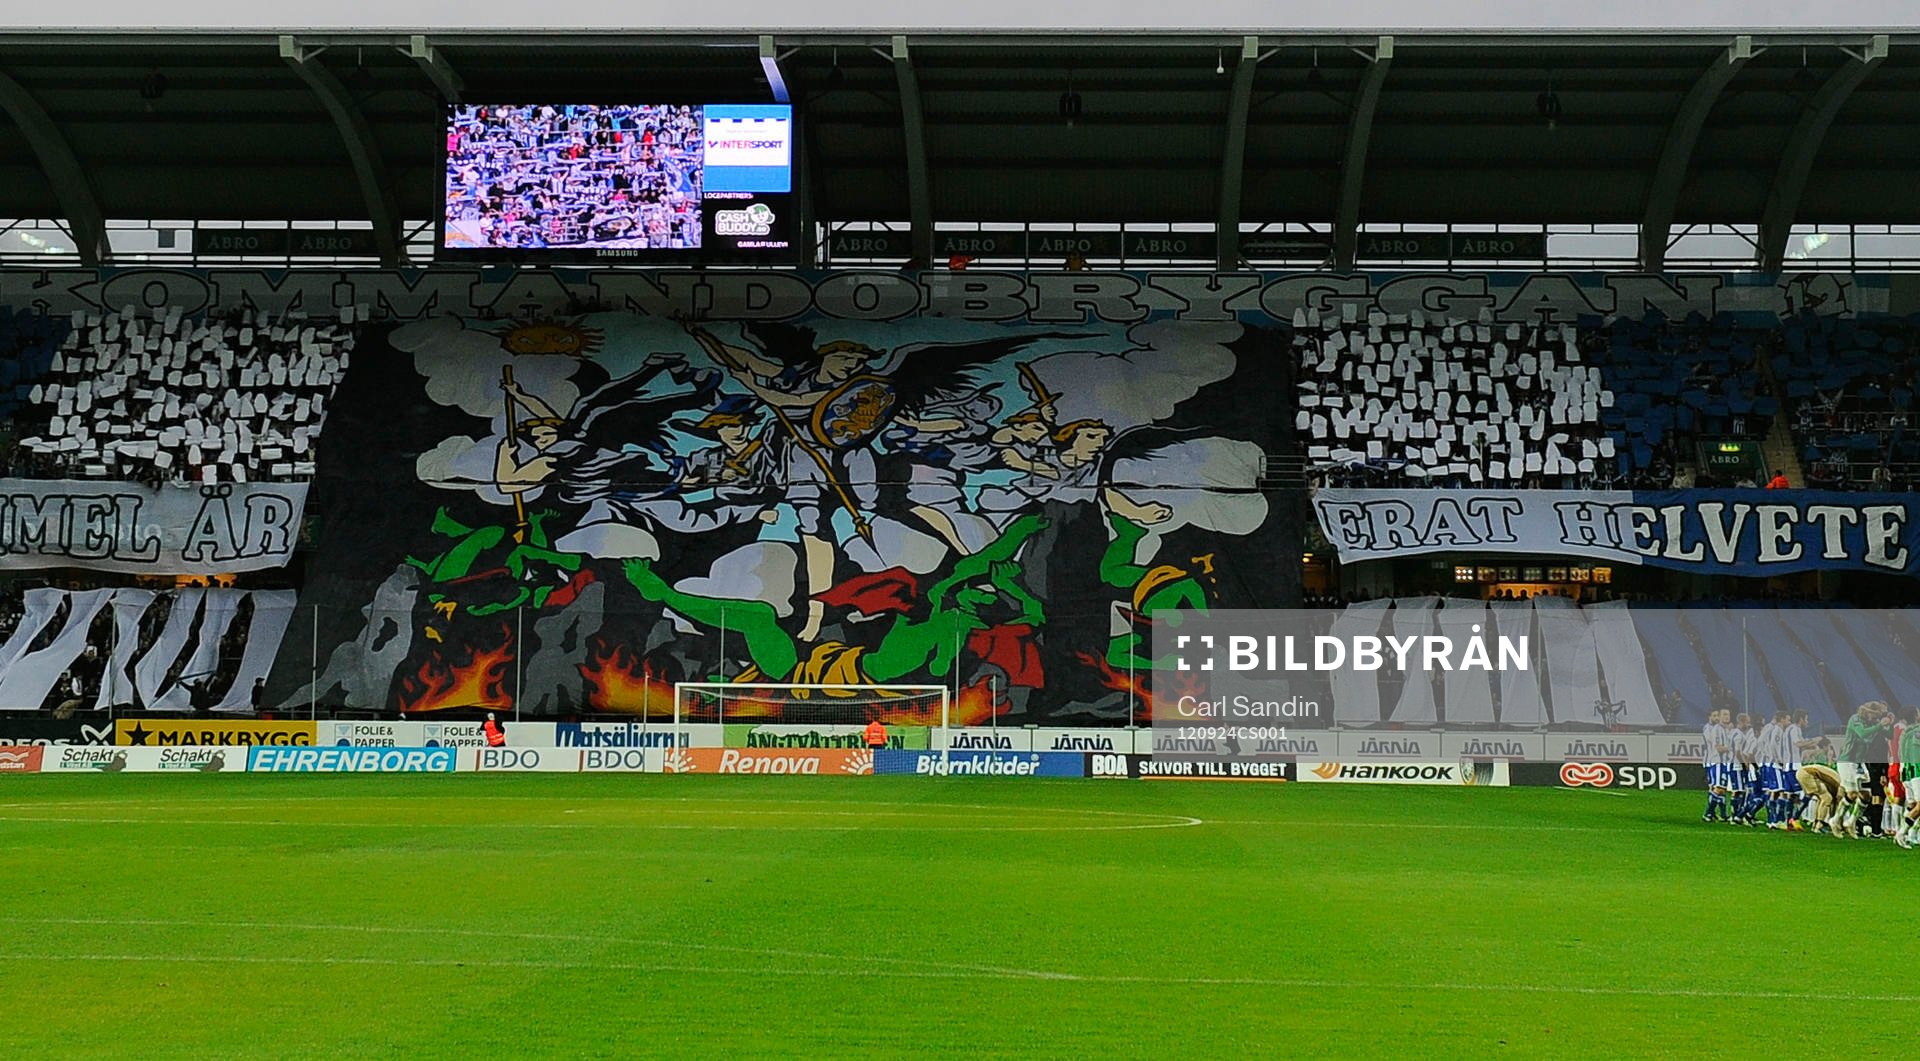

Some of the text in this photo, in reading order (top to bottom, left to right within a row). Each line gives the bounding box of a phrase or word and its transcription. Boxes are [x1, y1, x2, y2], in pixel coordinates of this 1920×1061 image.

[720, 140, 783, 149] INTERSPORT
[718, 213, 749, 222] CASH
[836, 236, 889, 252] ÅBRO
[944, 236, 996, 252] ÅBRO
[1040, 236, 1092, 252] ÅBRO
[1135, 236, 1188, 253] ÅBRO
[1366, 237, 1420, 253] ÅBRO
[1462, 237, 1515, 253] ÅBRO
[596, 249, 639, 257] SAMSUNG
[0, 268, 1724, 323] KOMMANDOBRYGGAN
[1709, 454, 1740, 464] ÅBRO
[182, 484, 293, 563] ÄR
[1318, 497, 1909, 569] ERAT HELVETE
[158, 731, 309, 747] MARKBYGG
[354, 738, 395, 748] PAPPER
[62, 748, 113, 762] Schakt
[159, 748, 211, 762] Schakt
[251, 750, 450, 772] EHRENBORG
[484, 750, 540, 768] BDO
[587, 750, 644, 768] BDO
[718, 750, 820, 774] Renova
[916, 753, 1040, 776] Björnkläder
[1092, 754, 1129, 775] BOA
[1139, 760, 1287, 776] SKIVOR TILL BYGGET
